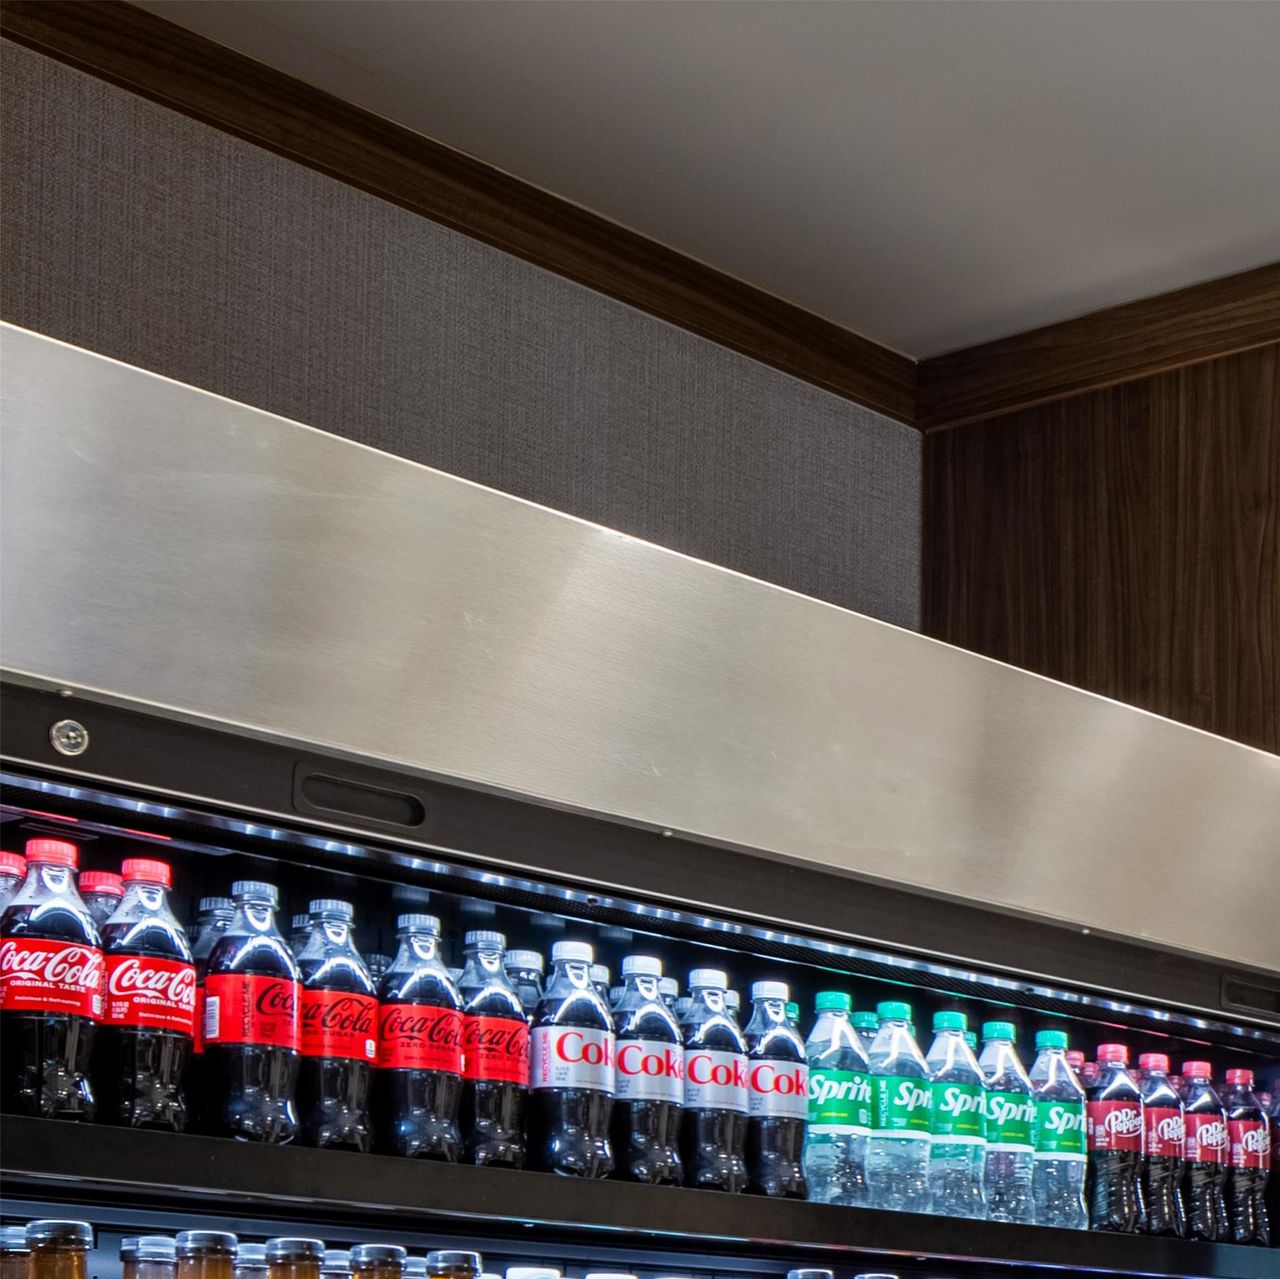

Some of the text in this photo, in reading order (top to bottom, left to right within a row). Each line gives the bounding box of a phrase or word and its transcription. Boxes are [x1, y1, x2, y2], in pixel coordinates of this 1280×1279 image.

[10, 979, 87, 994] ORIGINAL TASTE
[133, 996, 176, 1009] ORIGINAL
